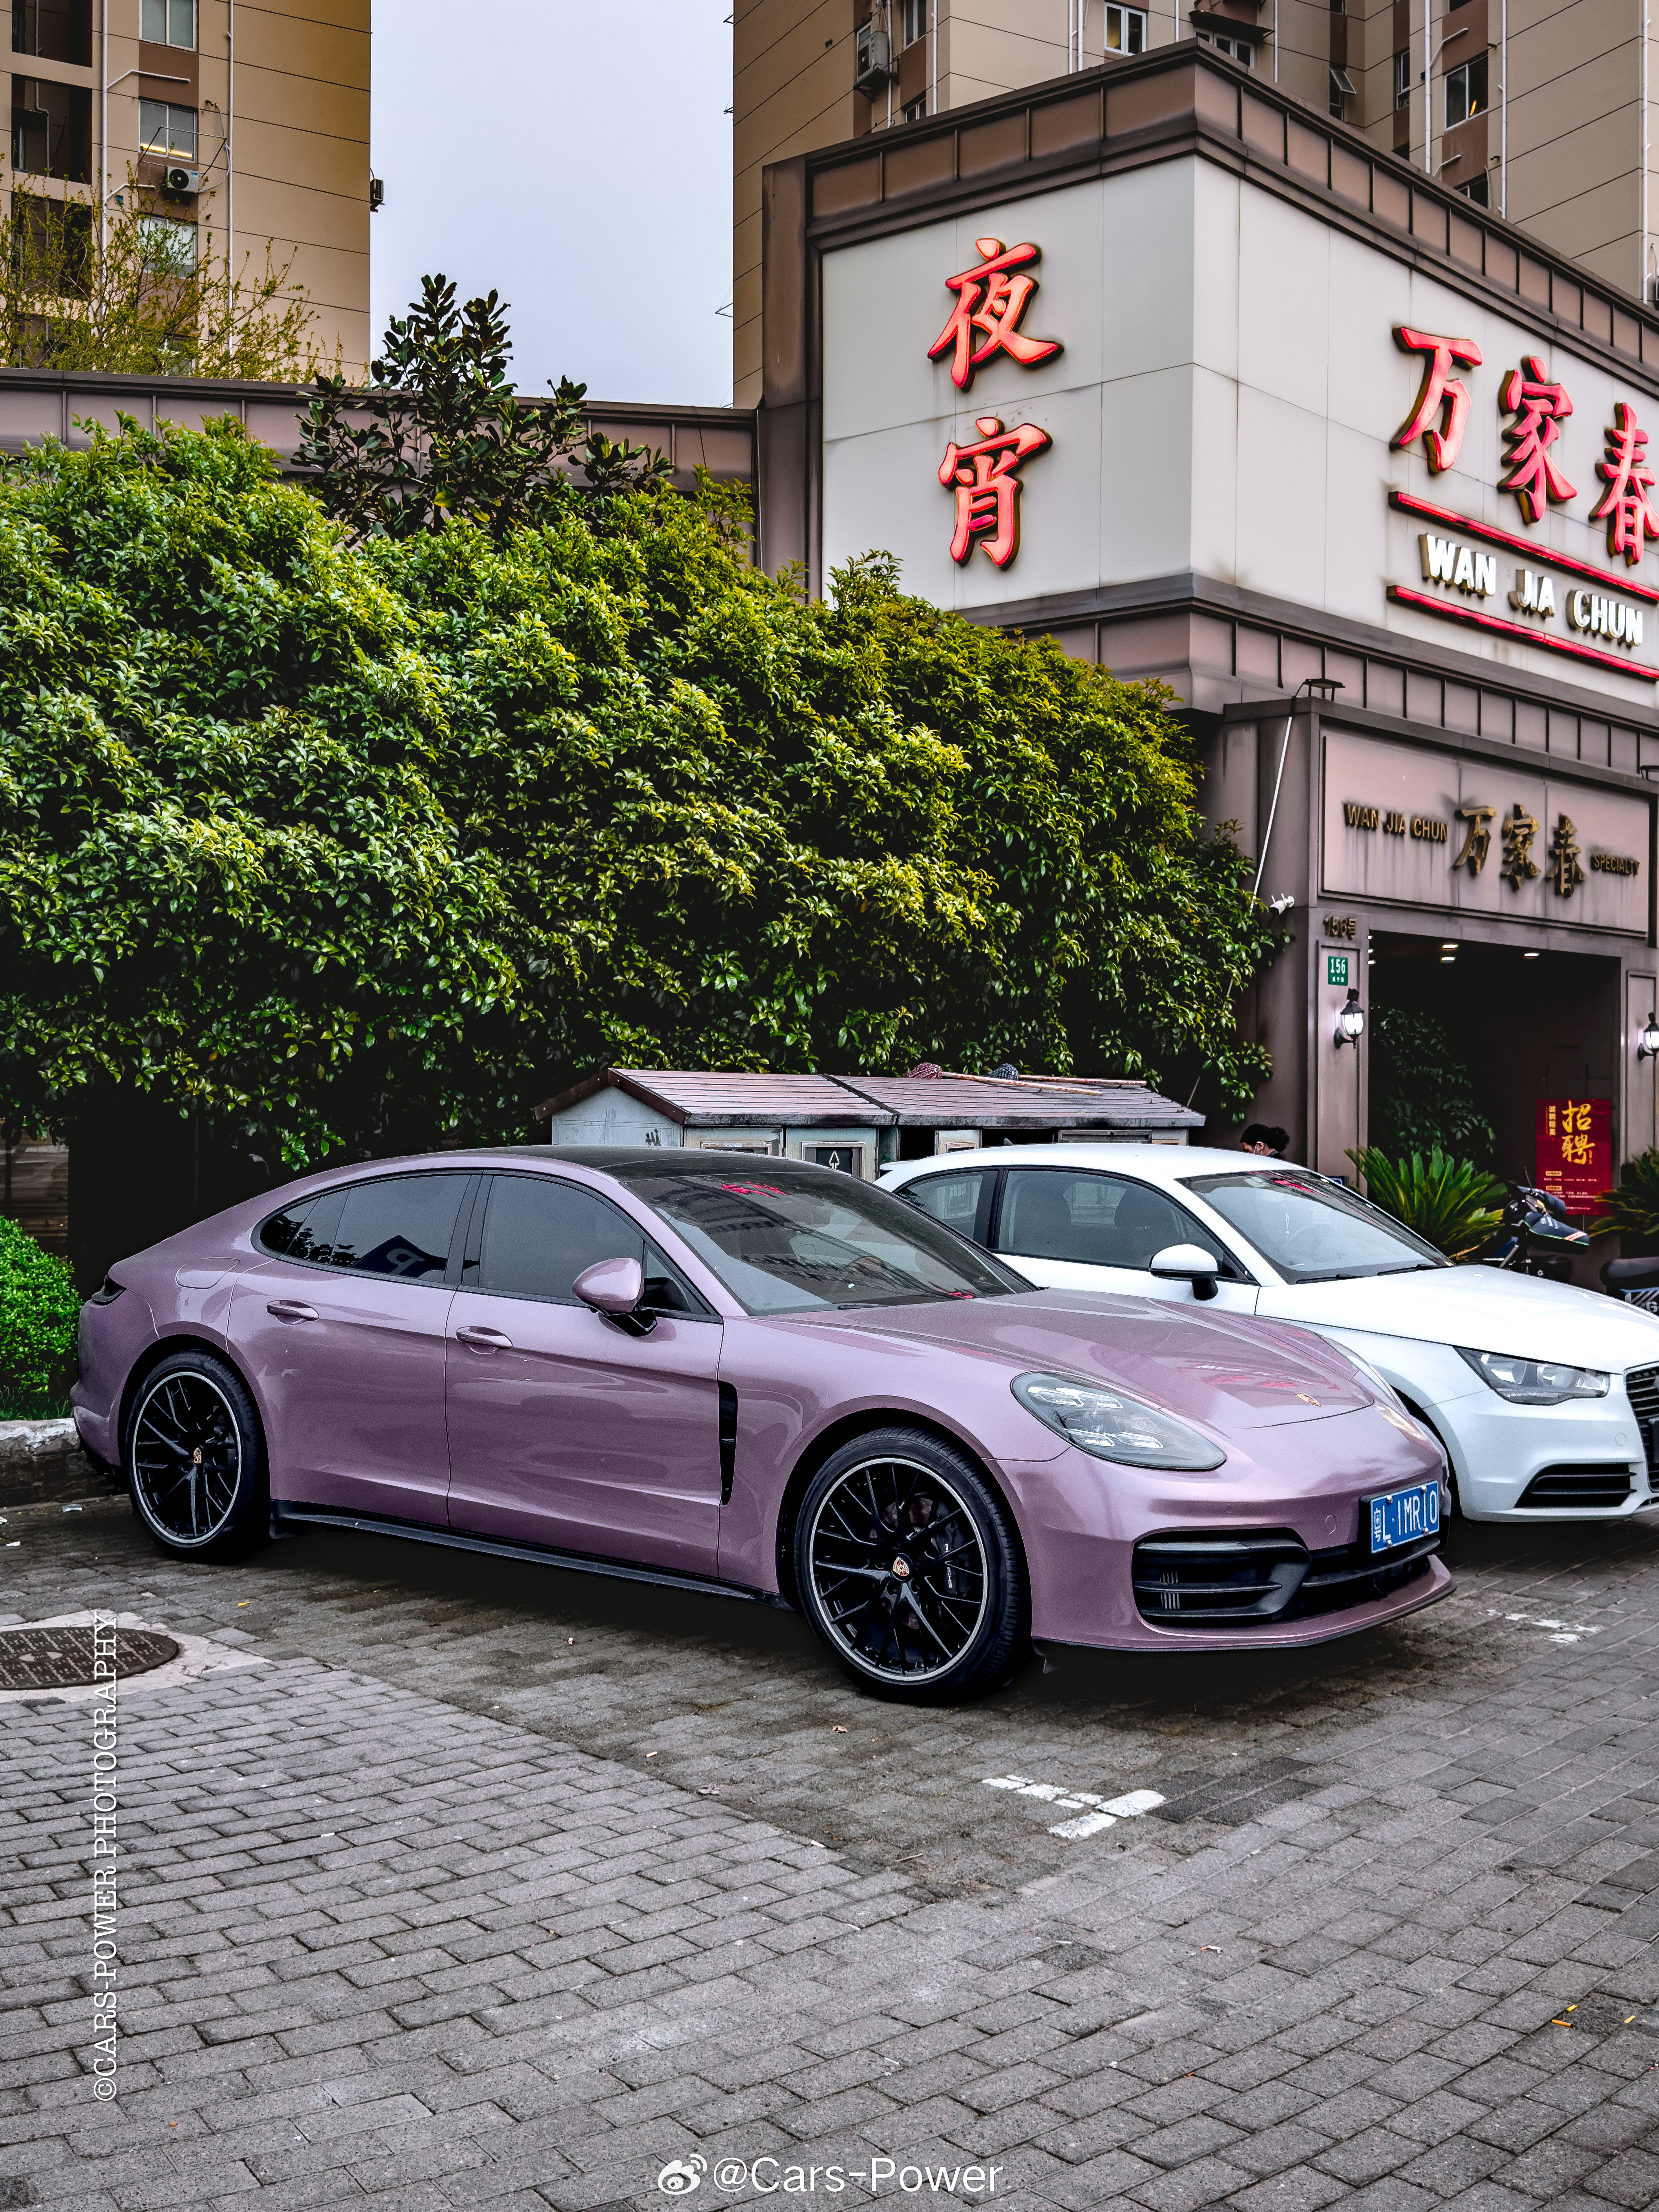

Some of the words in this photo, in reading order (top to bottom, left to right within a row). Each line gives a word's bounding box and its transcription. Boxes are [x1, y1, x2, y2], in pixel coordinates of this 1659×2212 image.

[928, 238, 1063, 569] 夜宵
[1392, 327, 1659, 566] 万家春
[1419, 533, 1496, 596] WAN
[1509, 569, 1555, 617] JIA
[1568, 589, 1643, 646] CHUN
[1344, 804, 1380, 831] WAN
[1384, 812, 1406, 835] JIA
[1410, 818, 1448, 843] CHUN
[1453, 803, 1586, 898] 万家春
[1591, 854, 1640, 876] SPECIALTY
[1323, 916, 1356, 940] 156号
[1330, 958, 1345, 974] 156
[1562, 1100, 1595, 1164] 招聘
